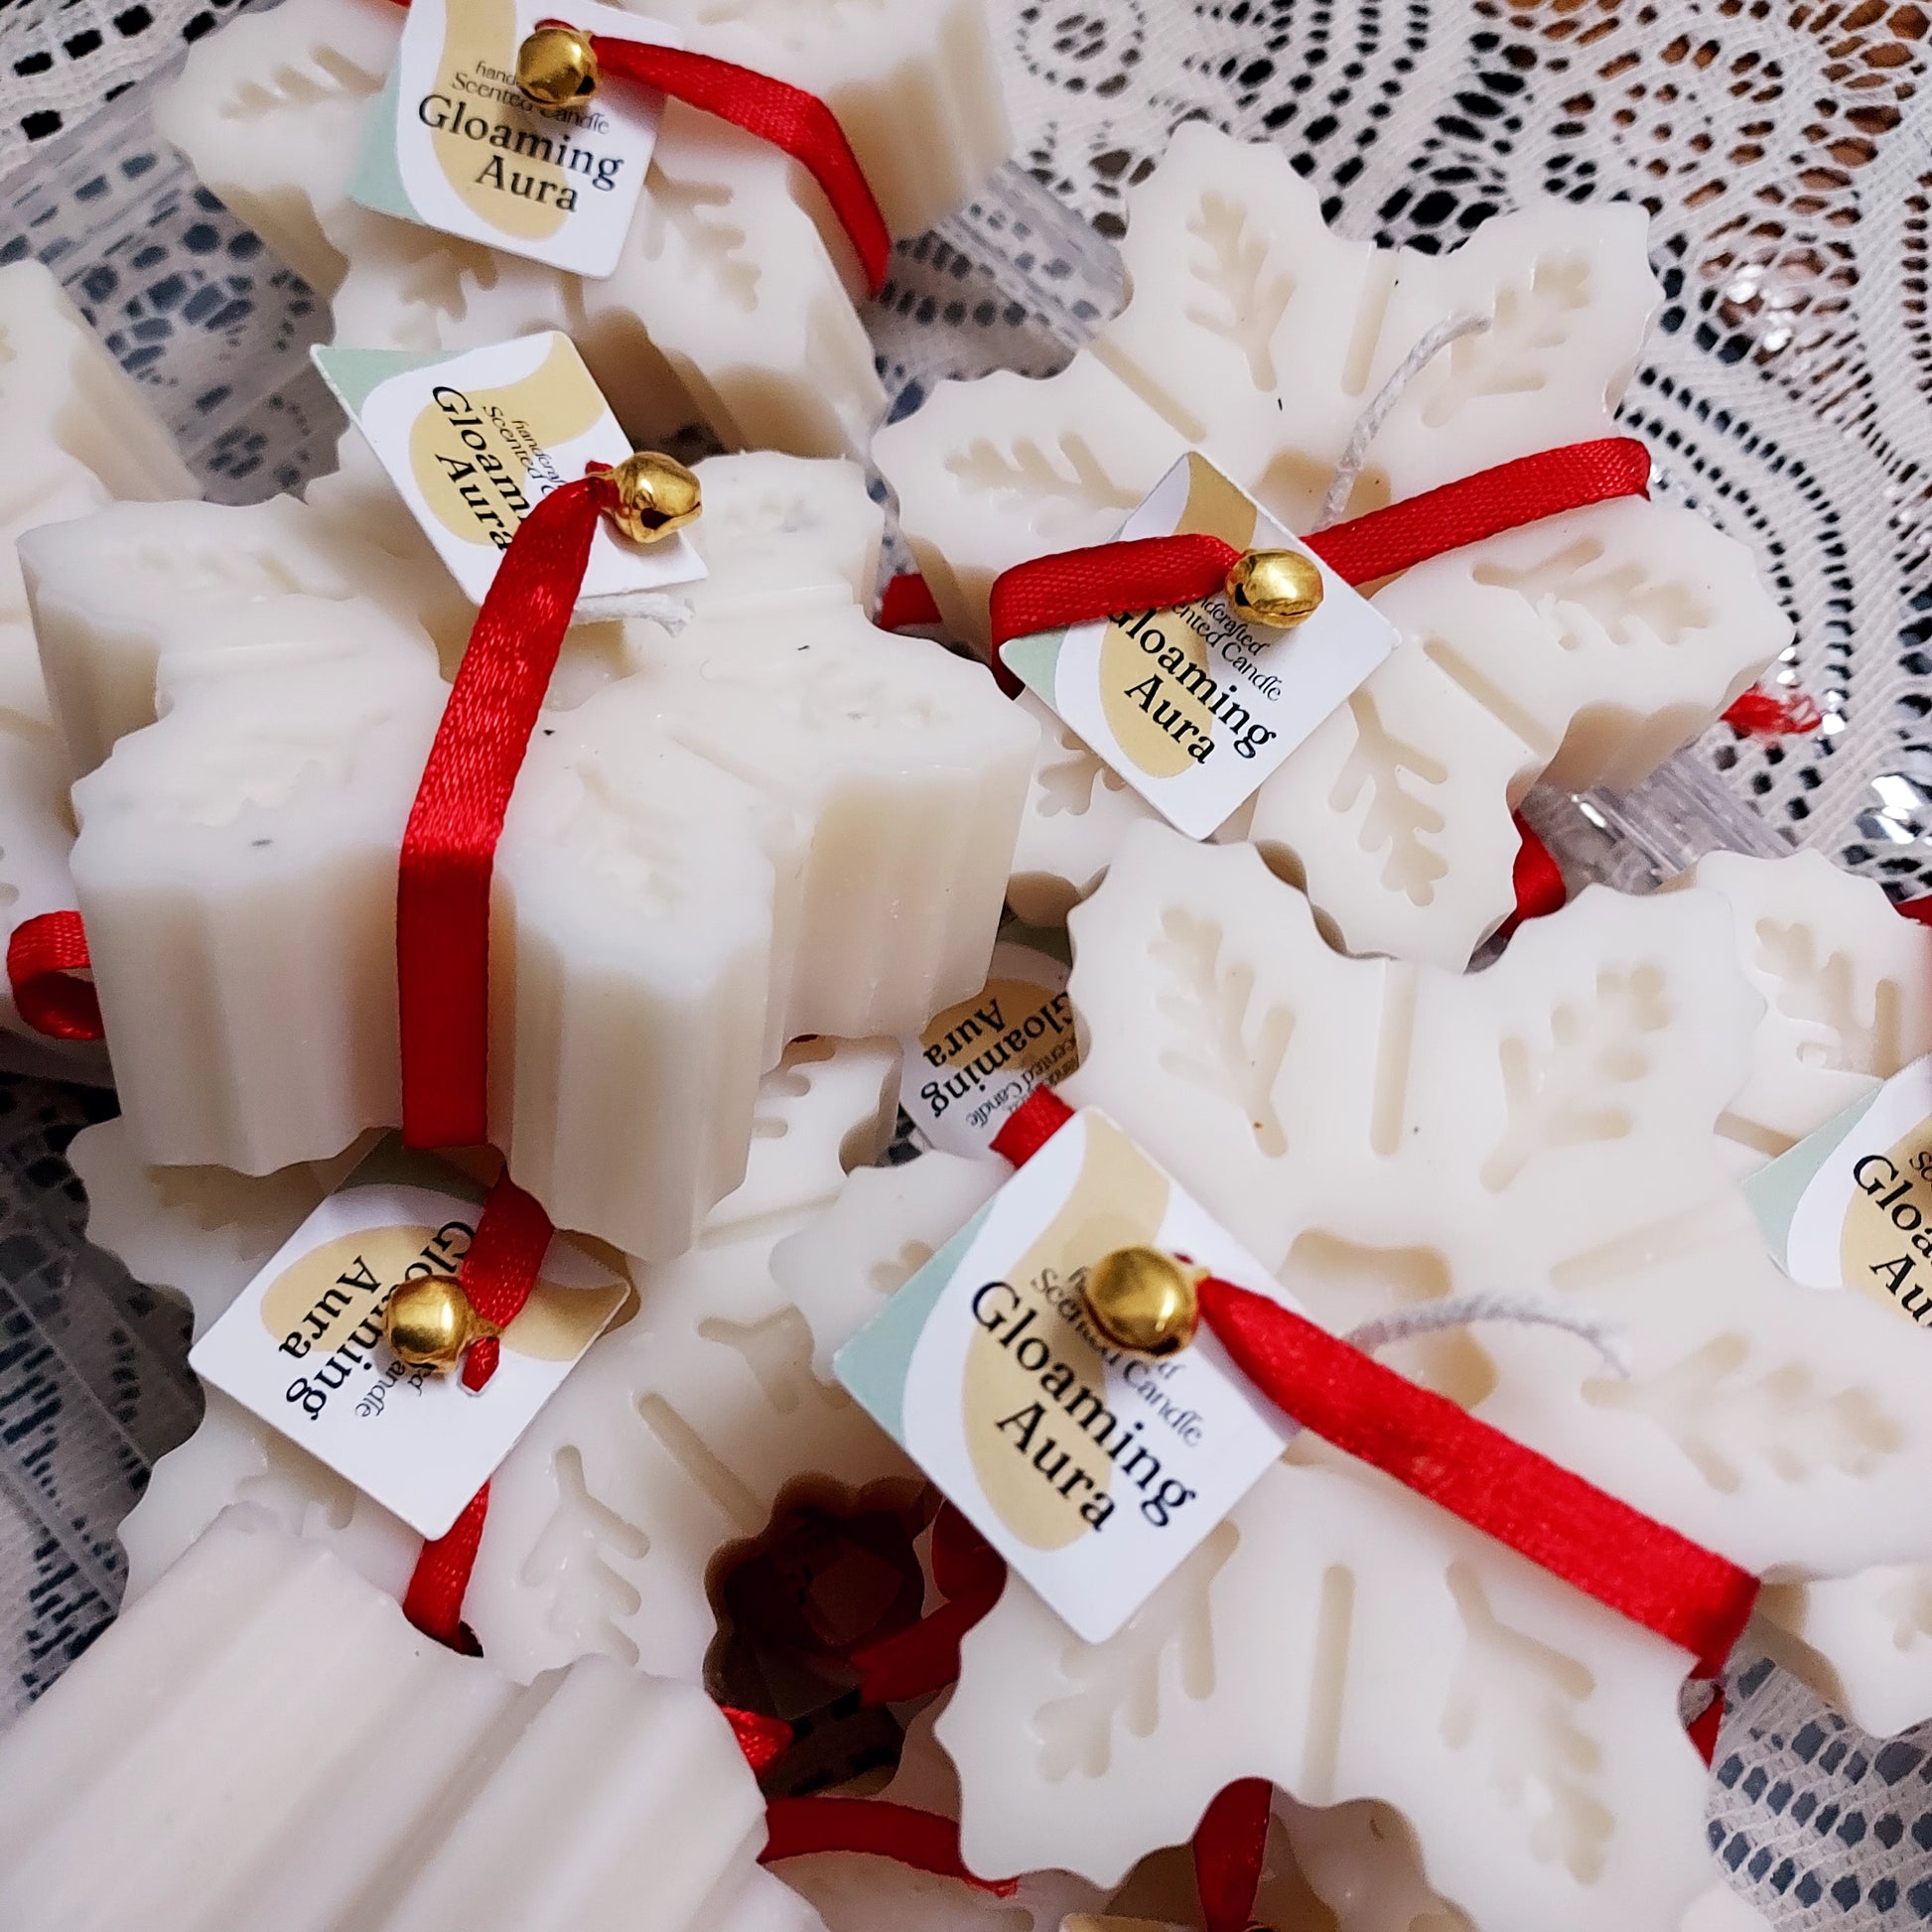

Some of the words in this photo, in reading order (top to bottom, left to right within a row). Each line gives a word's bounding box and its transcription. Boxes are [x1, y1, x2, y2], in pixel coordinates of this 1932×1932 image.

[418, 94, 624, 192] Gloaming
[475, 154, 579, 212] Aura
[432, 386, 530, 523] Gloam
[482, 406, 547, 480] Scented
[435, 453, 513, 550] Aura
[1173, 604, 1227, 647] ented
[1222, 641, 1283, 701] Candle
[1124, 673, 1216, 764] Aura
[922, 998, 1006, 1067] Aura
[966, 1082, 1023, 1127] Candle
[1854, 1155, 1932, 1258] Gloa
[278, 1255, 381, 1359] Aura
[1868, 1253, 1932, 1326] Au
[355, 1360, 406, 1417] andle
[972, 1281, 1196, 1528] Gloaming
[1123, 1359, 1202, 1447] Candle
[995, 1401, 1115, 1532] Aura
